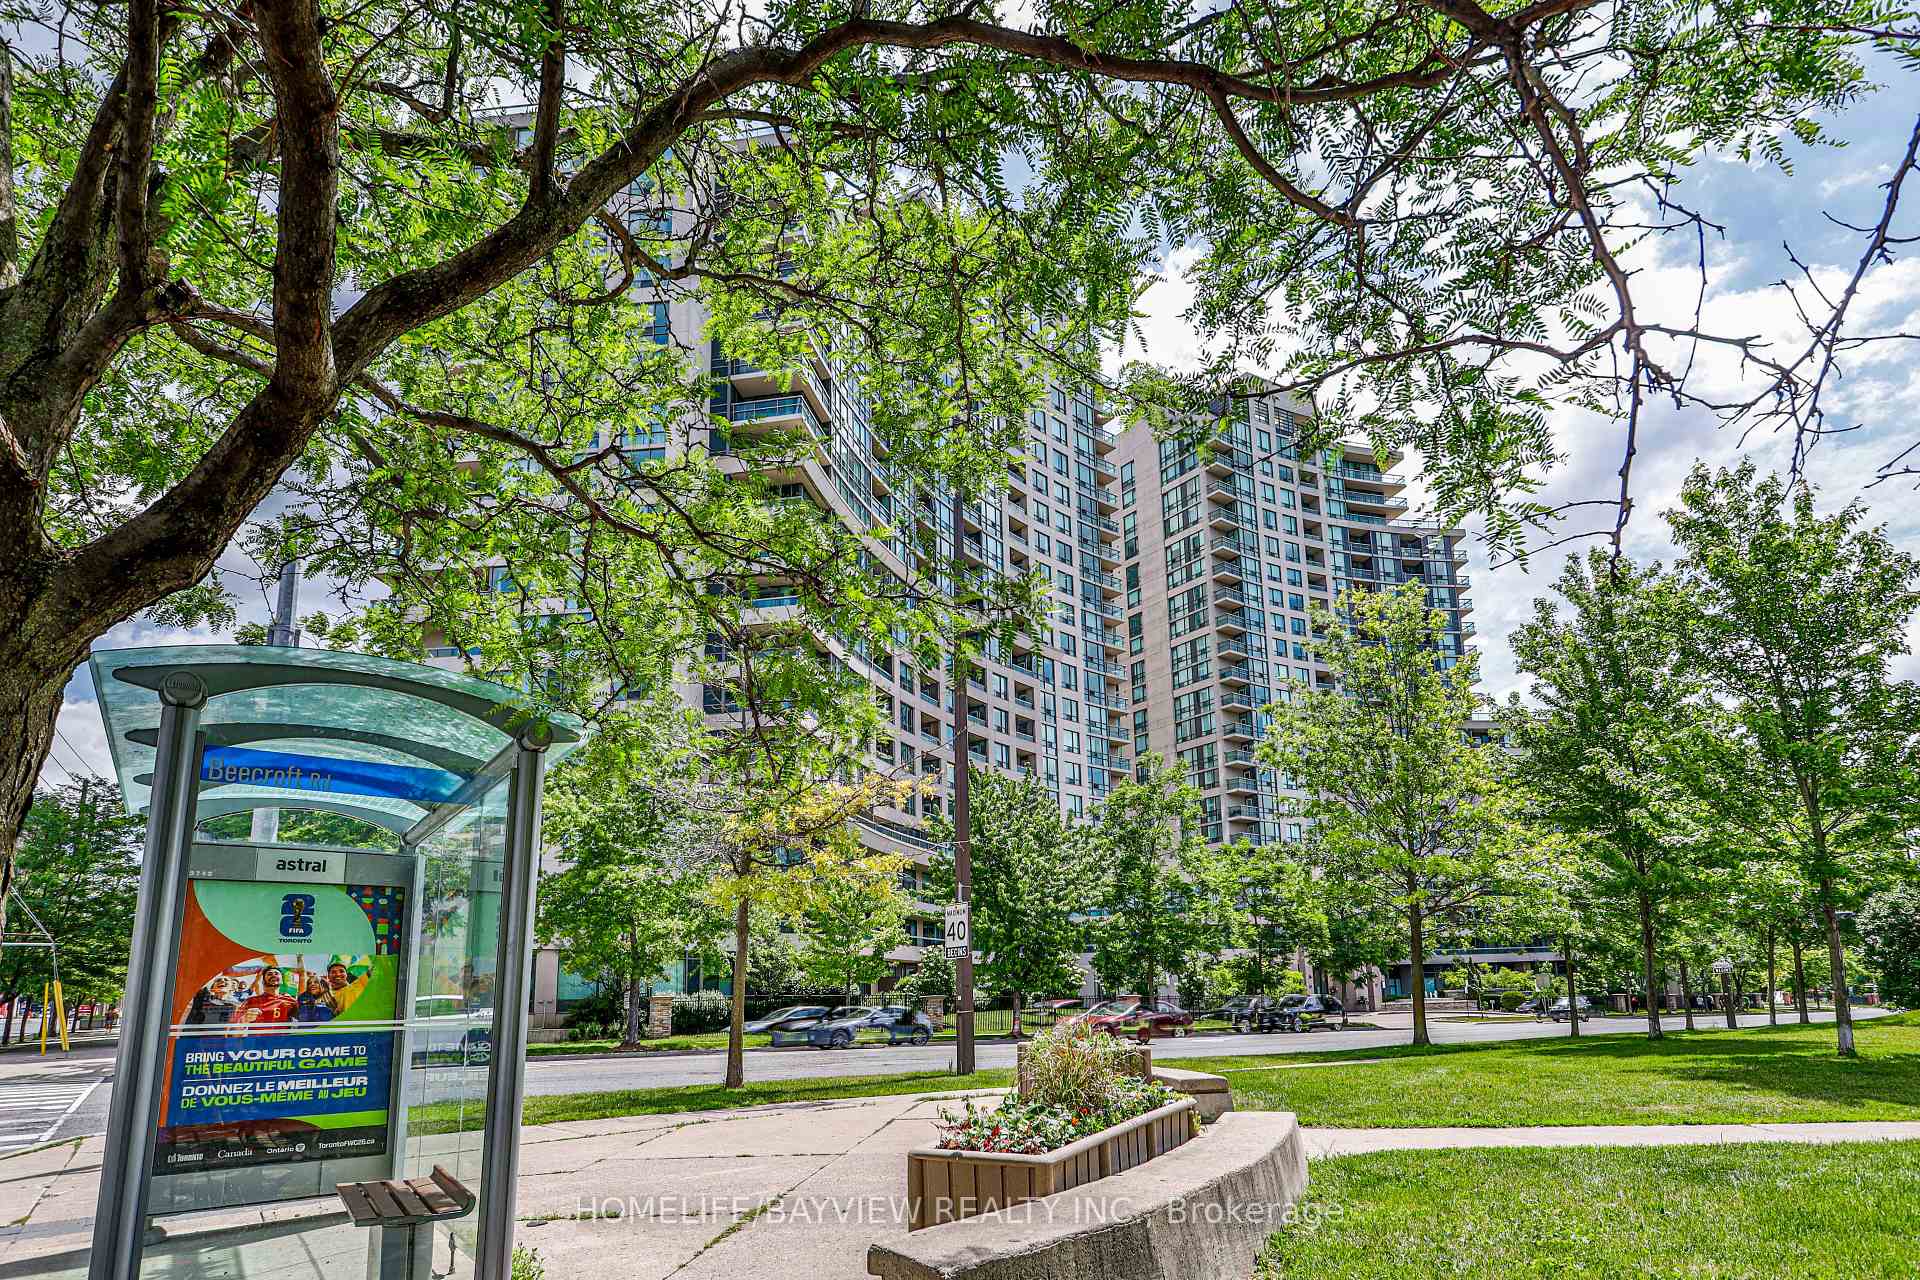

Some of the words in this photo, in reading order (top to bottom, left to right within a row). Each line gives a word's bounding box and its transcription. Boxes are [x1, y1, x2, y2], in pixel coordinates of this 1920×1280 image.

[208, 755, 303, 790] Beecroft
[310, 772, 332, 792] Rd
[276, 858, 327, 873] astral
[947, 921, 966, 941] 40
[947, 947, 967, 957] BEGINS
[185, 1051, 225, 1063] BRING
[227, 1048, 296, 1061] YOUR
[298, 1046, 351, 1058] GAME
[352, 1045, 367, 1055] TO
[184, 1064, 209, 1075] THE
[212, 1059, 296, 1073] BEAUTIFUL
[298, 1056, 368, 1069] GAME
[182, 1082, 254, 1097] DONNEZ
[256, 1081, 275, 1092] LE
[277, 1076, 368, 1091] MEILLEUR
[181, 1098, 197, 1109] DE
[201, 1089, 313, 1107] VOUS-MÊME
[331, 1087, 367, 1098] JEU
[217, 1147, 253, 1159] Canada
[266, 1146, 294, 1154] Ontario
